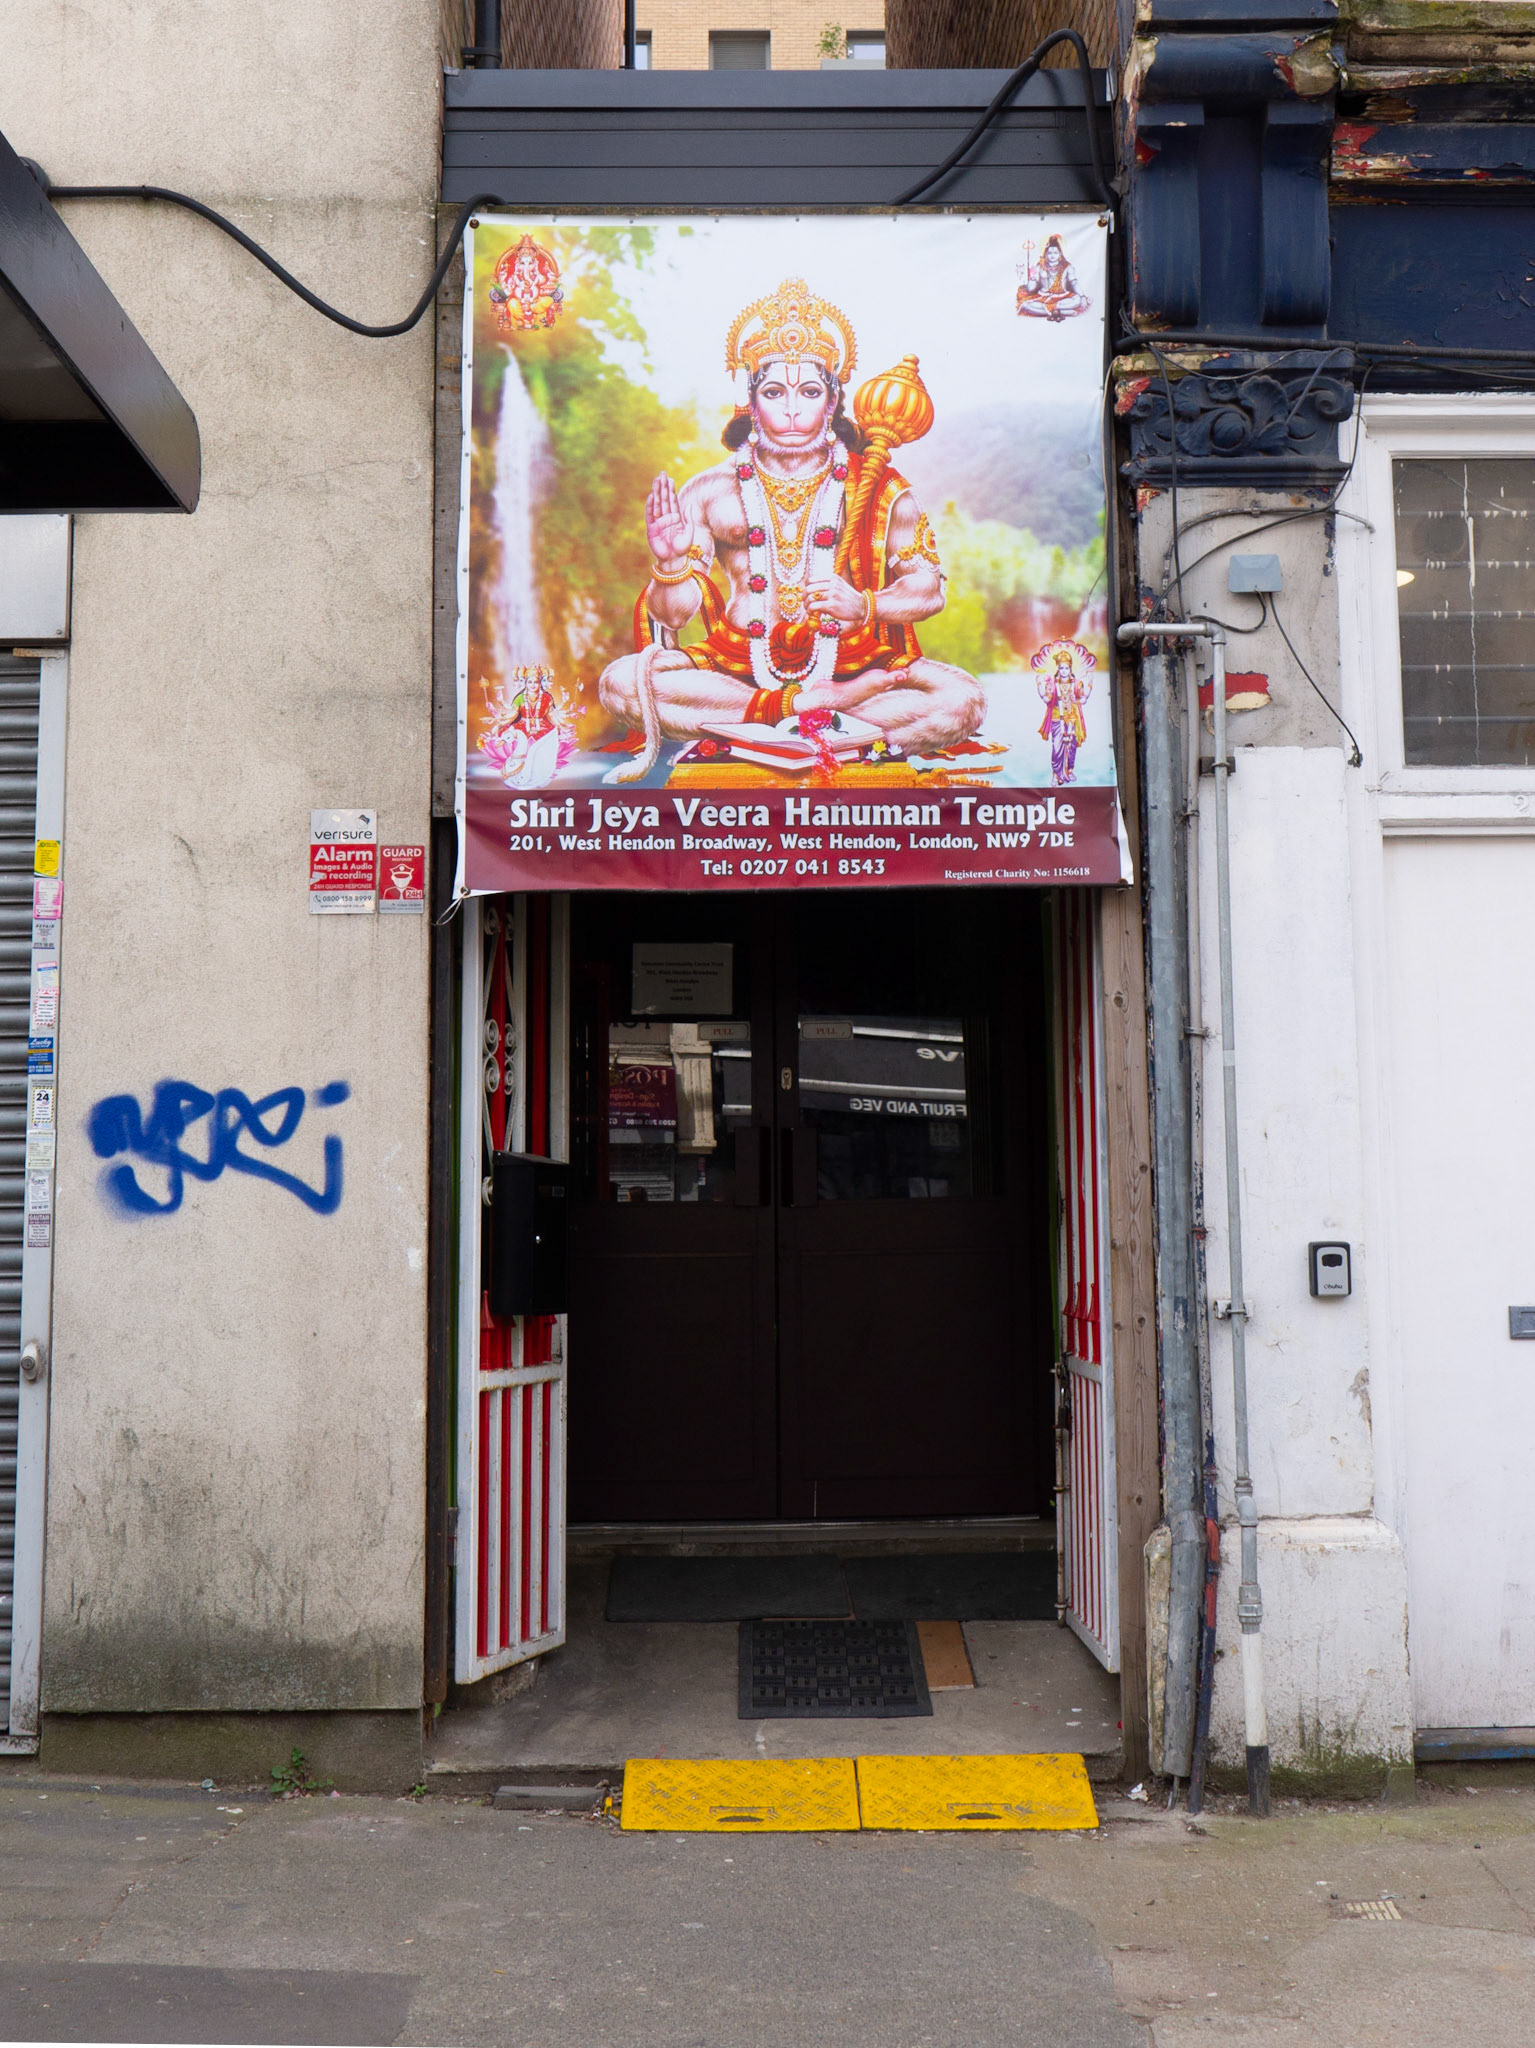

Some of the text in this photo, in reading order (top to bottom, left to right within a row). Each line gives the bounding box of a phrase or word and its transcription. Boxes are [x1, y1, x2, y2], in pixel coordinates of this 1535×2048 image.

[510, 797, 1075, 833] Shri Jeya Veera Hanuman Temple
[315, 830, 372, 839] verisure
[510, 832, 1074, 853] 201, West Hendon Broadway, West Hendon, London, NW9 7DE
[314, 847, 372, 861] Alarm
[383, 848, 422, 857] GUARD
[700, 859, 885, 875] Tel: 0207 041 8543
[944, 867, 1090, 880] Registered Charity No: 1156618
[329, 871, 372, 881] recording
[36, 1093, 49, 1101] 24
